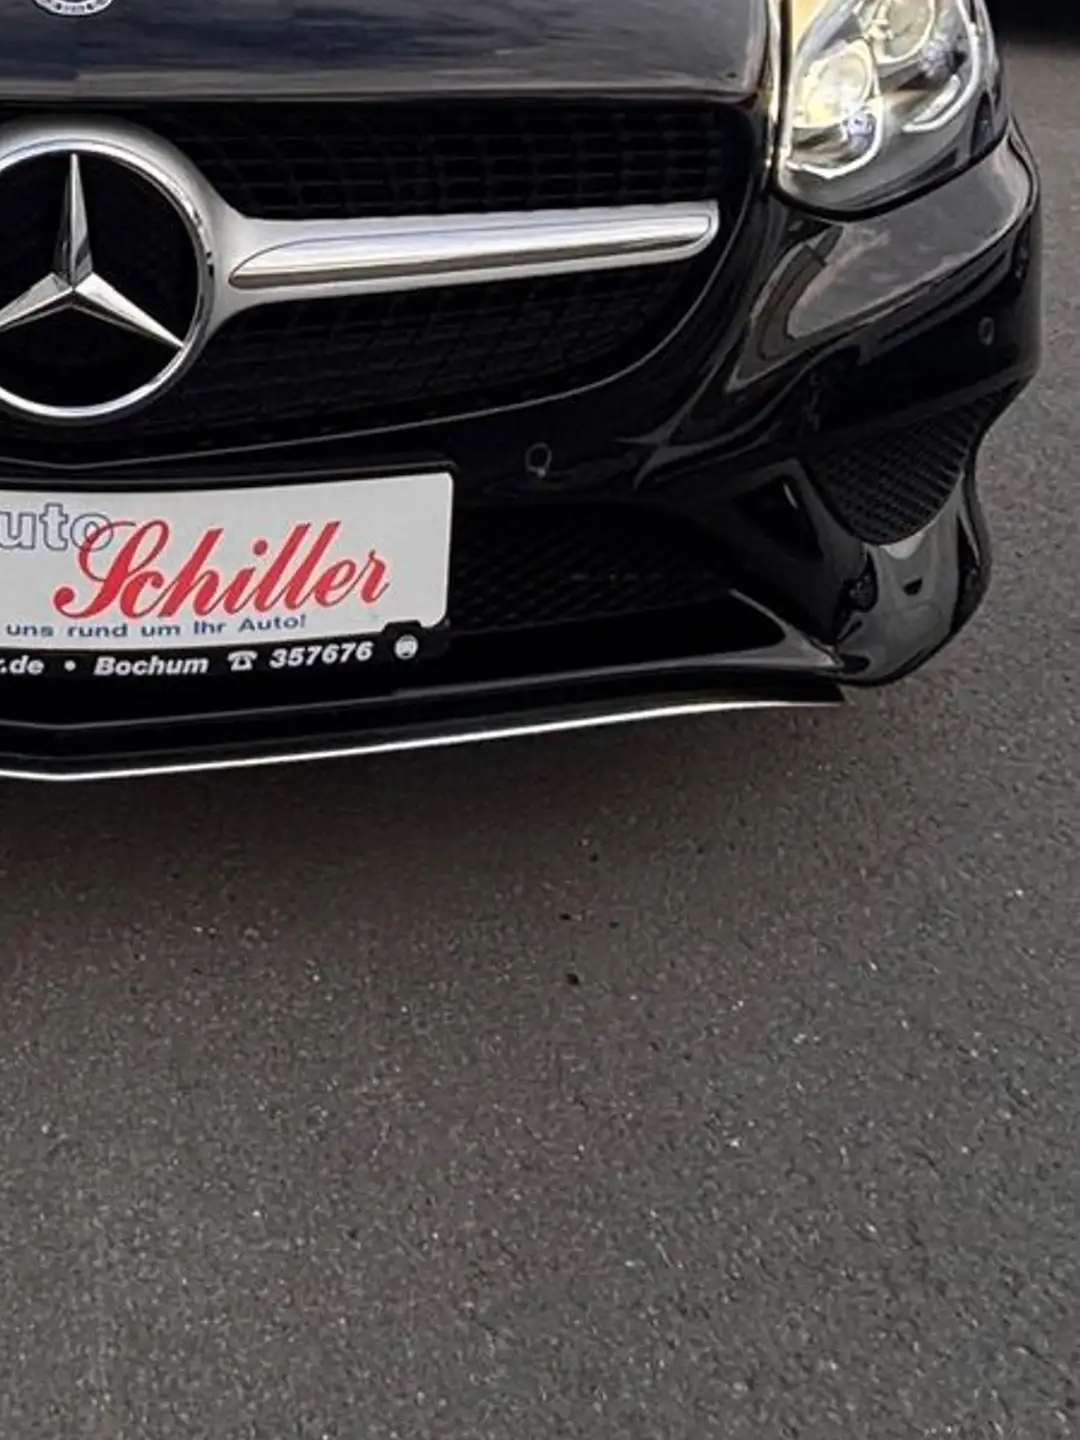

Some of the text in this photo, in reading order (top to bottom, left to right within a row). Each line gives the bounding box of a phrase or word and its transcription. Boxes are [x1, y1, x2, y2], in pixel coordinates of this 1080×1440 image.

[53, 519, 390, 620] Schiller
[6, 623, 54, 638] uns
[67, 621, 129, 639] rund
[140, 623, 181, 638] um
[193, 619, 225, 635] Ihr
[237, 613, 307, 633] Auto!
[93, 655, 209, 676] Bochum
[269, 640, 374, 669] 357676
